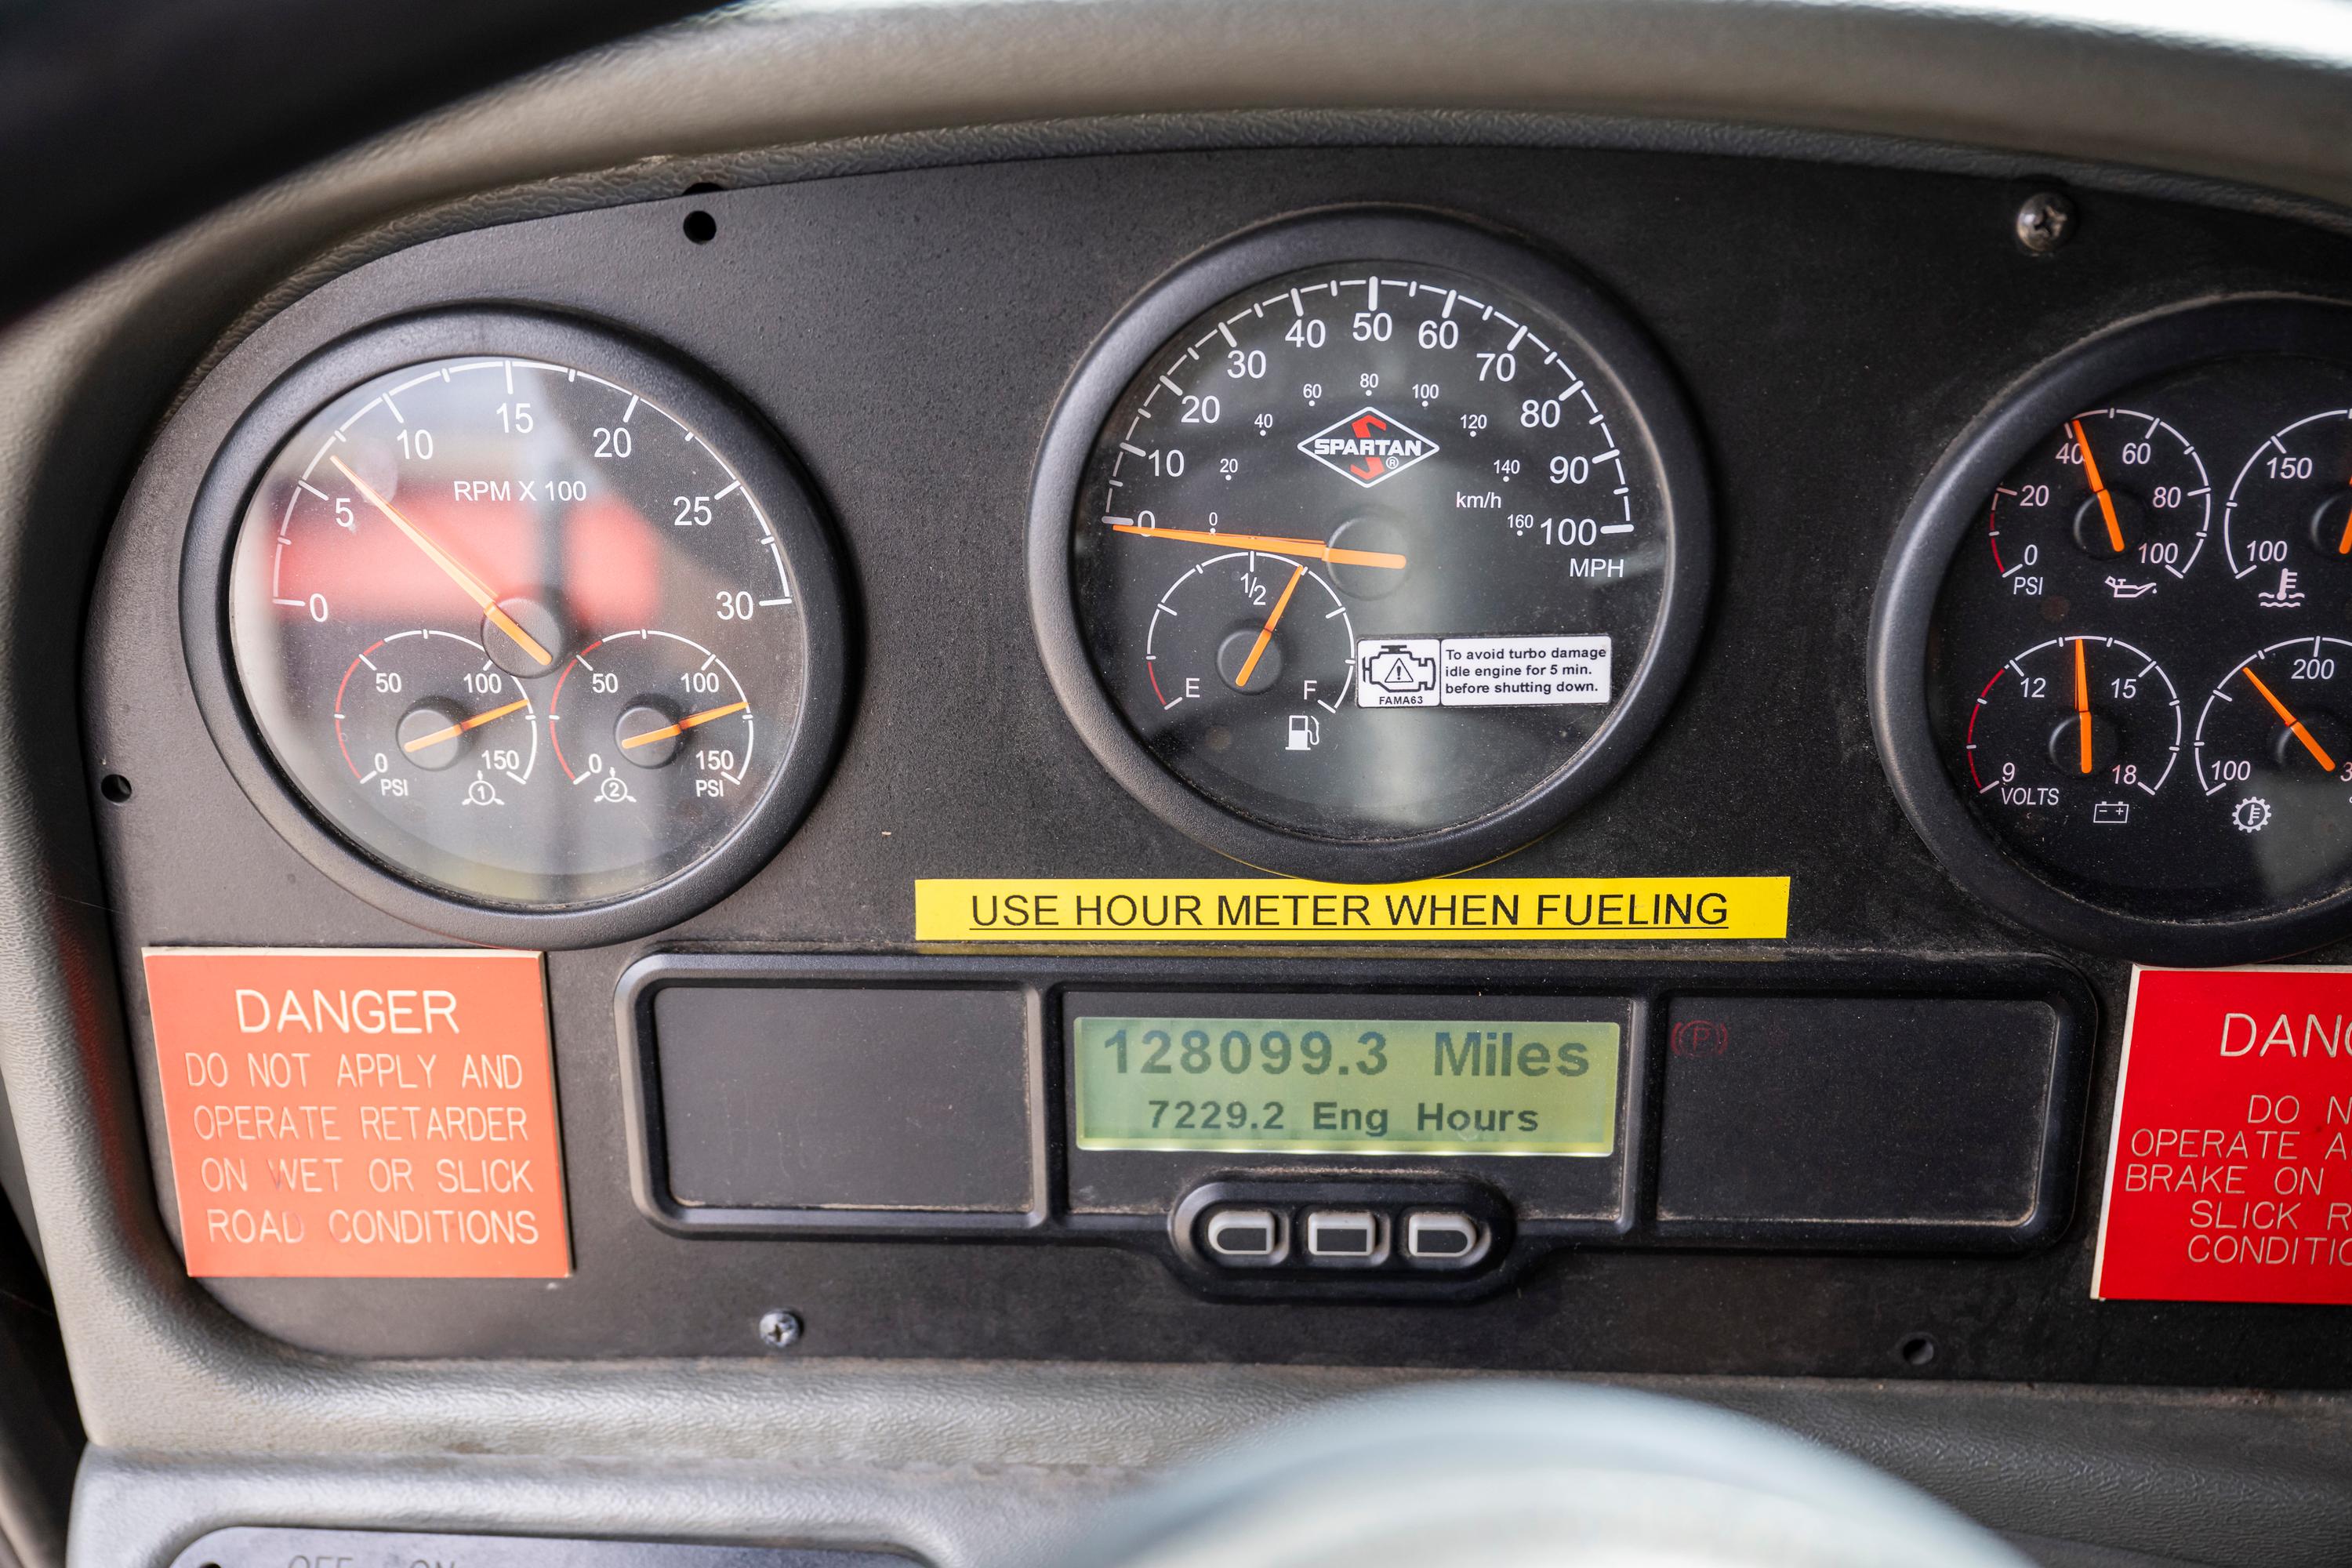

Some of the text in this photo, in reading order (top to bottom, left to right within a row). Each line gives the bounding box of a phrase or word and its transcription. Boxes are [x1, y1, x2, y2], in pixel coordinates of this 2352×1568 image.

[1285, 319, 1326, 348] 40
[1352, 314, 1392, 342] 50
[1418, 320, 1458, 350] 60
[1227, 350, 1267, 379] 30
[1475, 353, 1516, 382] 70
[1302, 384, 1322, 399] 60
[1359, 373, 1379, 389] 80
[1412, 384, 1439, 399] 100
[496, 404, 533, 434] 15
[1181, 396, 1221, 424] 20
[1521, 399, 1560, 428] 80
[1254, 414, 1273, 429] 40
[1460, 414, 1487, 430] 120
[397, 430, 434, 459] 10
[593, 429, 632, 458] 20
[1314, 438, 1421, 456] SPARTAN
[2056, 443, 2085, 464] 40
[2122, 443, 2151, 464] 60
[1149, 449, 1185, 477] 10
[1219, 459, 1239, 474] 20
[1494, 460, 1520, 474] 140
[1549, 456, 1589, 484] 90
[2267, 458, 2313, 480] 150
[454, 480, 586, 502] RPM X 100
[1456, 491, 1501, 509] km/h
[2020, 485, 2049, 506] 20
[2153, 487, 2181, 508] 80
[336, 499, 354, 527] 5
[673, 497, 712, 526] 25
[1209, 512, 1218, 526] 0
[1507, 514, 1534, 529] 160
[1138, 510, 1156, 537] 0
[1540, 517, 1596, 546] 100
[2024, 546, 2038, 565] 0
[2139, 543, 2178, 564] 100
[2246, 541, 2287, 562] 100
[1570, 558, 1624, 579] MPH
[2013, 577, 2043, 595] PSI
[310, 593, 328, 622] 0
[716, 592, 753, 620] 30
[1446, 648, 1606, 660] To avoid turbo damage
[1446, 664, 1592, 680] idle engine for 5 min.
[2291, 659, 2335, 680] 200
[376, 673, 401, 692] 50
[464, 673, 502, 694] 100
[592, 673, 618, 693] 50
[681, 673, 720, 693] 100
[1186, 678, 1200, 697] E
[1304, 681, 1316, 699] F
[1446, 681, 1598, 695] before shutting down.
[2020, 678, 2046, 698] 12
[2111, 678, 2137, 698] 15
[1379, 695, 1423, 705] FAMA63
[374, 754, 388, 773] 0
[482, 750, 520, 771] 150
[588, 754, 602, 774] 0
[696, 751, 734, 771] 150
[2211, 760, 2251, 780] 100
[2002, 763, 2015, 782] 9
[2112, 764, 2136, 785] 18
[382, 779, 408, 797] PSI
[609, 783, 620, 797] 2
[696, 779, 724, 797] PSI
[2001, 787, 2060, 806] VOLTS
[971, 892, 1728, 927] USE HOUR METER WHEN FUELING
[236, 989, 459, 1033] DANGER
[2220, 1013, 2352, 1058] DAN
[1104, 1029, 1589, 1078] 128099.3 Miles
[185, 1052, 523, 1089] DO NOT APPLY AND
[1148, 1099, 1540, 1138] 7229.2 Eng Hours
[2247, 1094, 2299, 1124] DO
[194, 1105, 528, 1142] OPERATE RETARDER
[2131, 1128, 2352, 1160] OPERATE A
[201, 1157, 534, 1193] ON WET OR SLICK
[2125, 1164, 2324, 1196] BRAKE ON
[2190, 1200, 2301, 1230] SLICK
[207, 1209, 539, 1244] ROAD CONDITIONS
